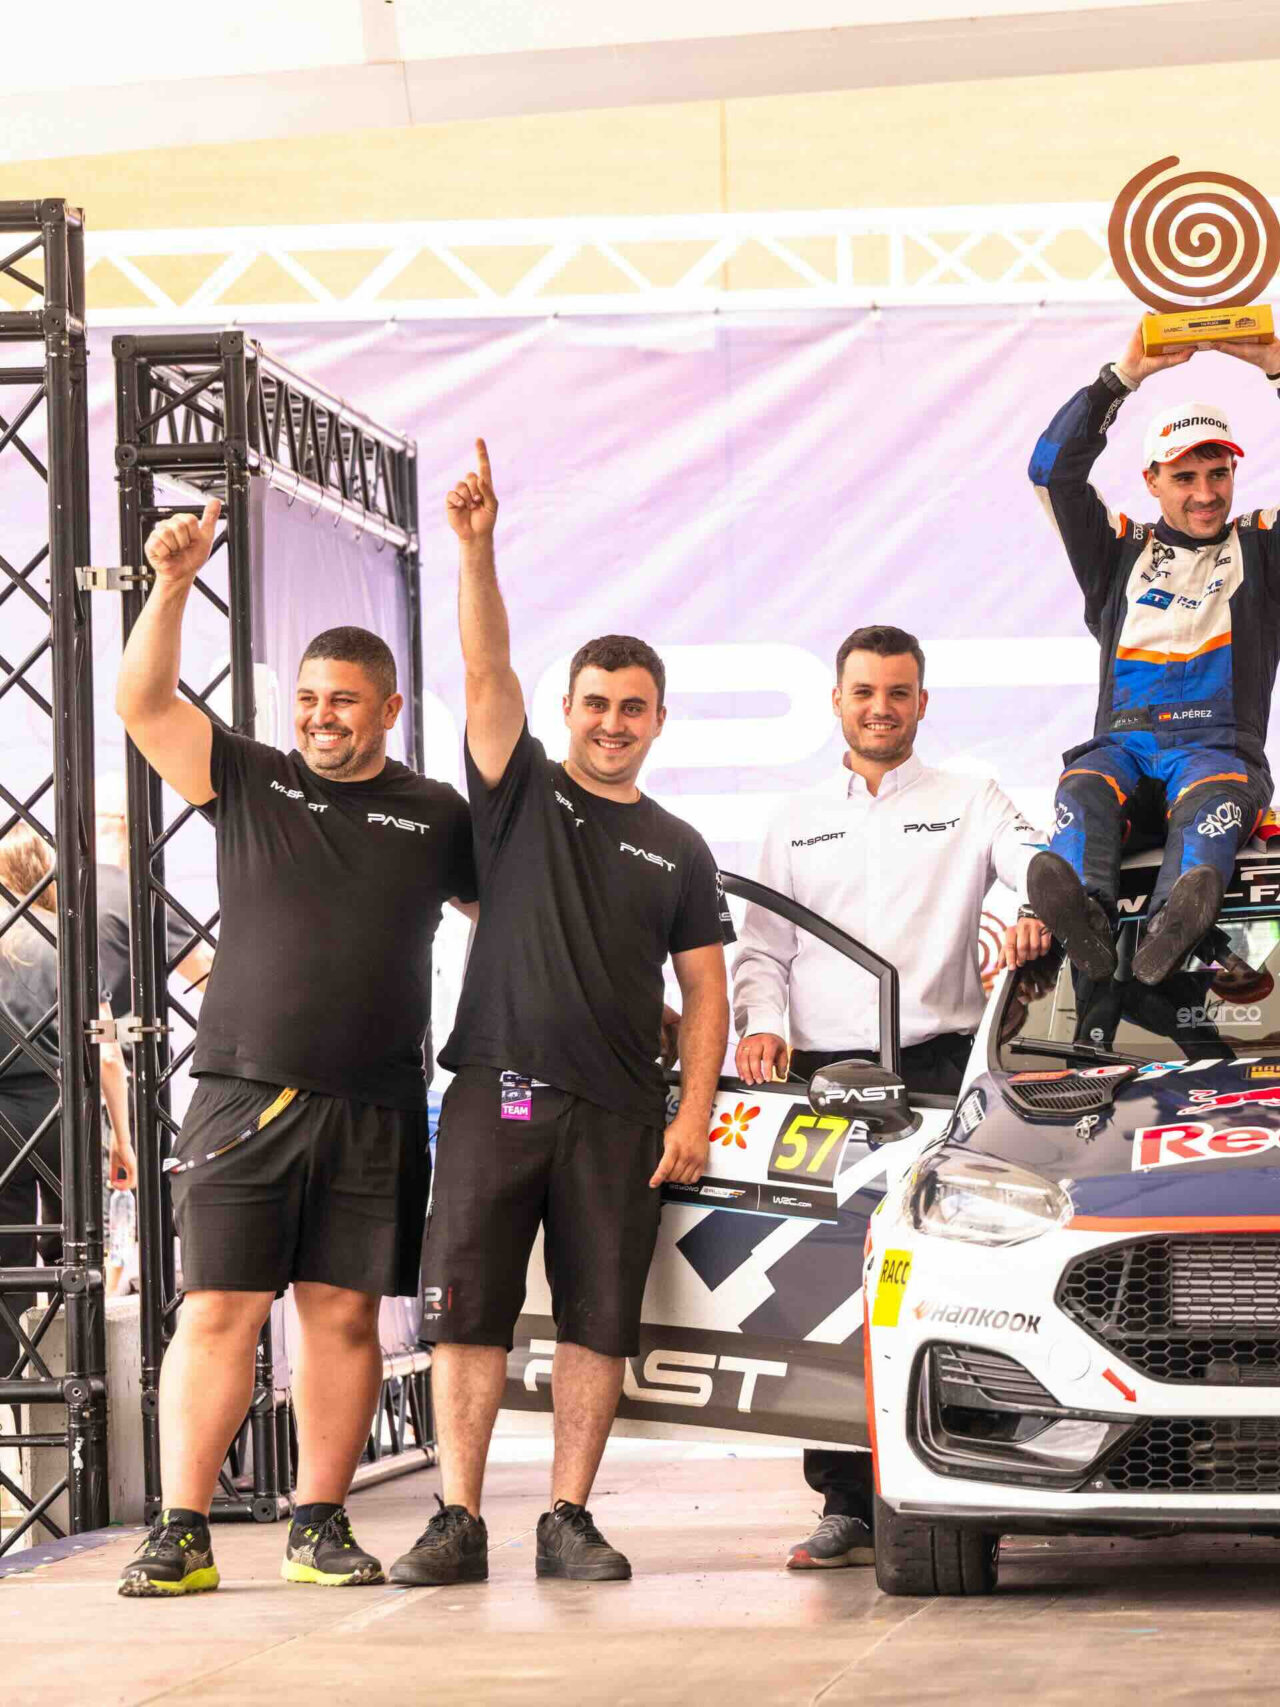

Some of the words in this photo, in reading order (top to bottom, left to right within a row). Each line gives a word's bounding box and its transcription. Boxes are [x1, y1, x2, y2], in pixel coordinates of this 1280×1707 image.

[1172, 708, 1213, 720] A.PÉREZ
[791, 831, 846, 848] M-SPORT
[503, 1105, 529, 1116] TEAM
[775, 1114, 850, 1173] 57
[880, 1259, 910, 1286] RACC
